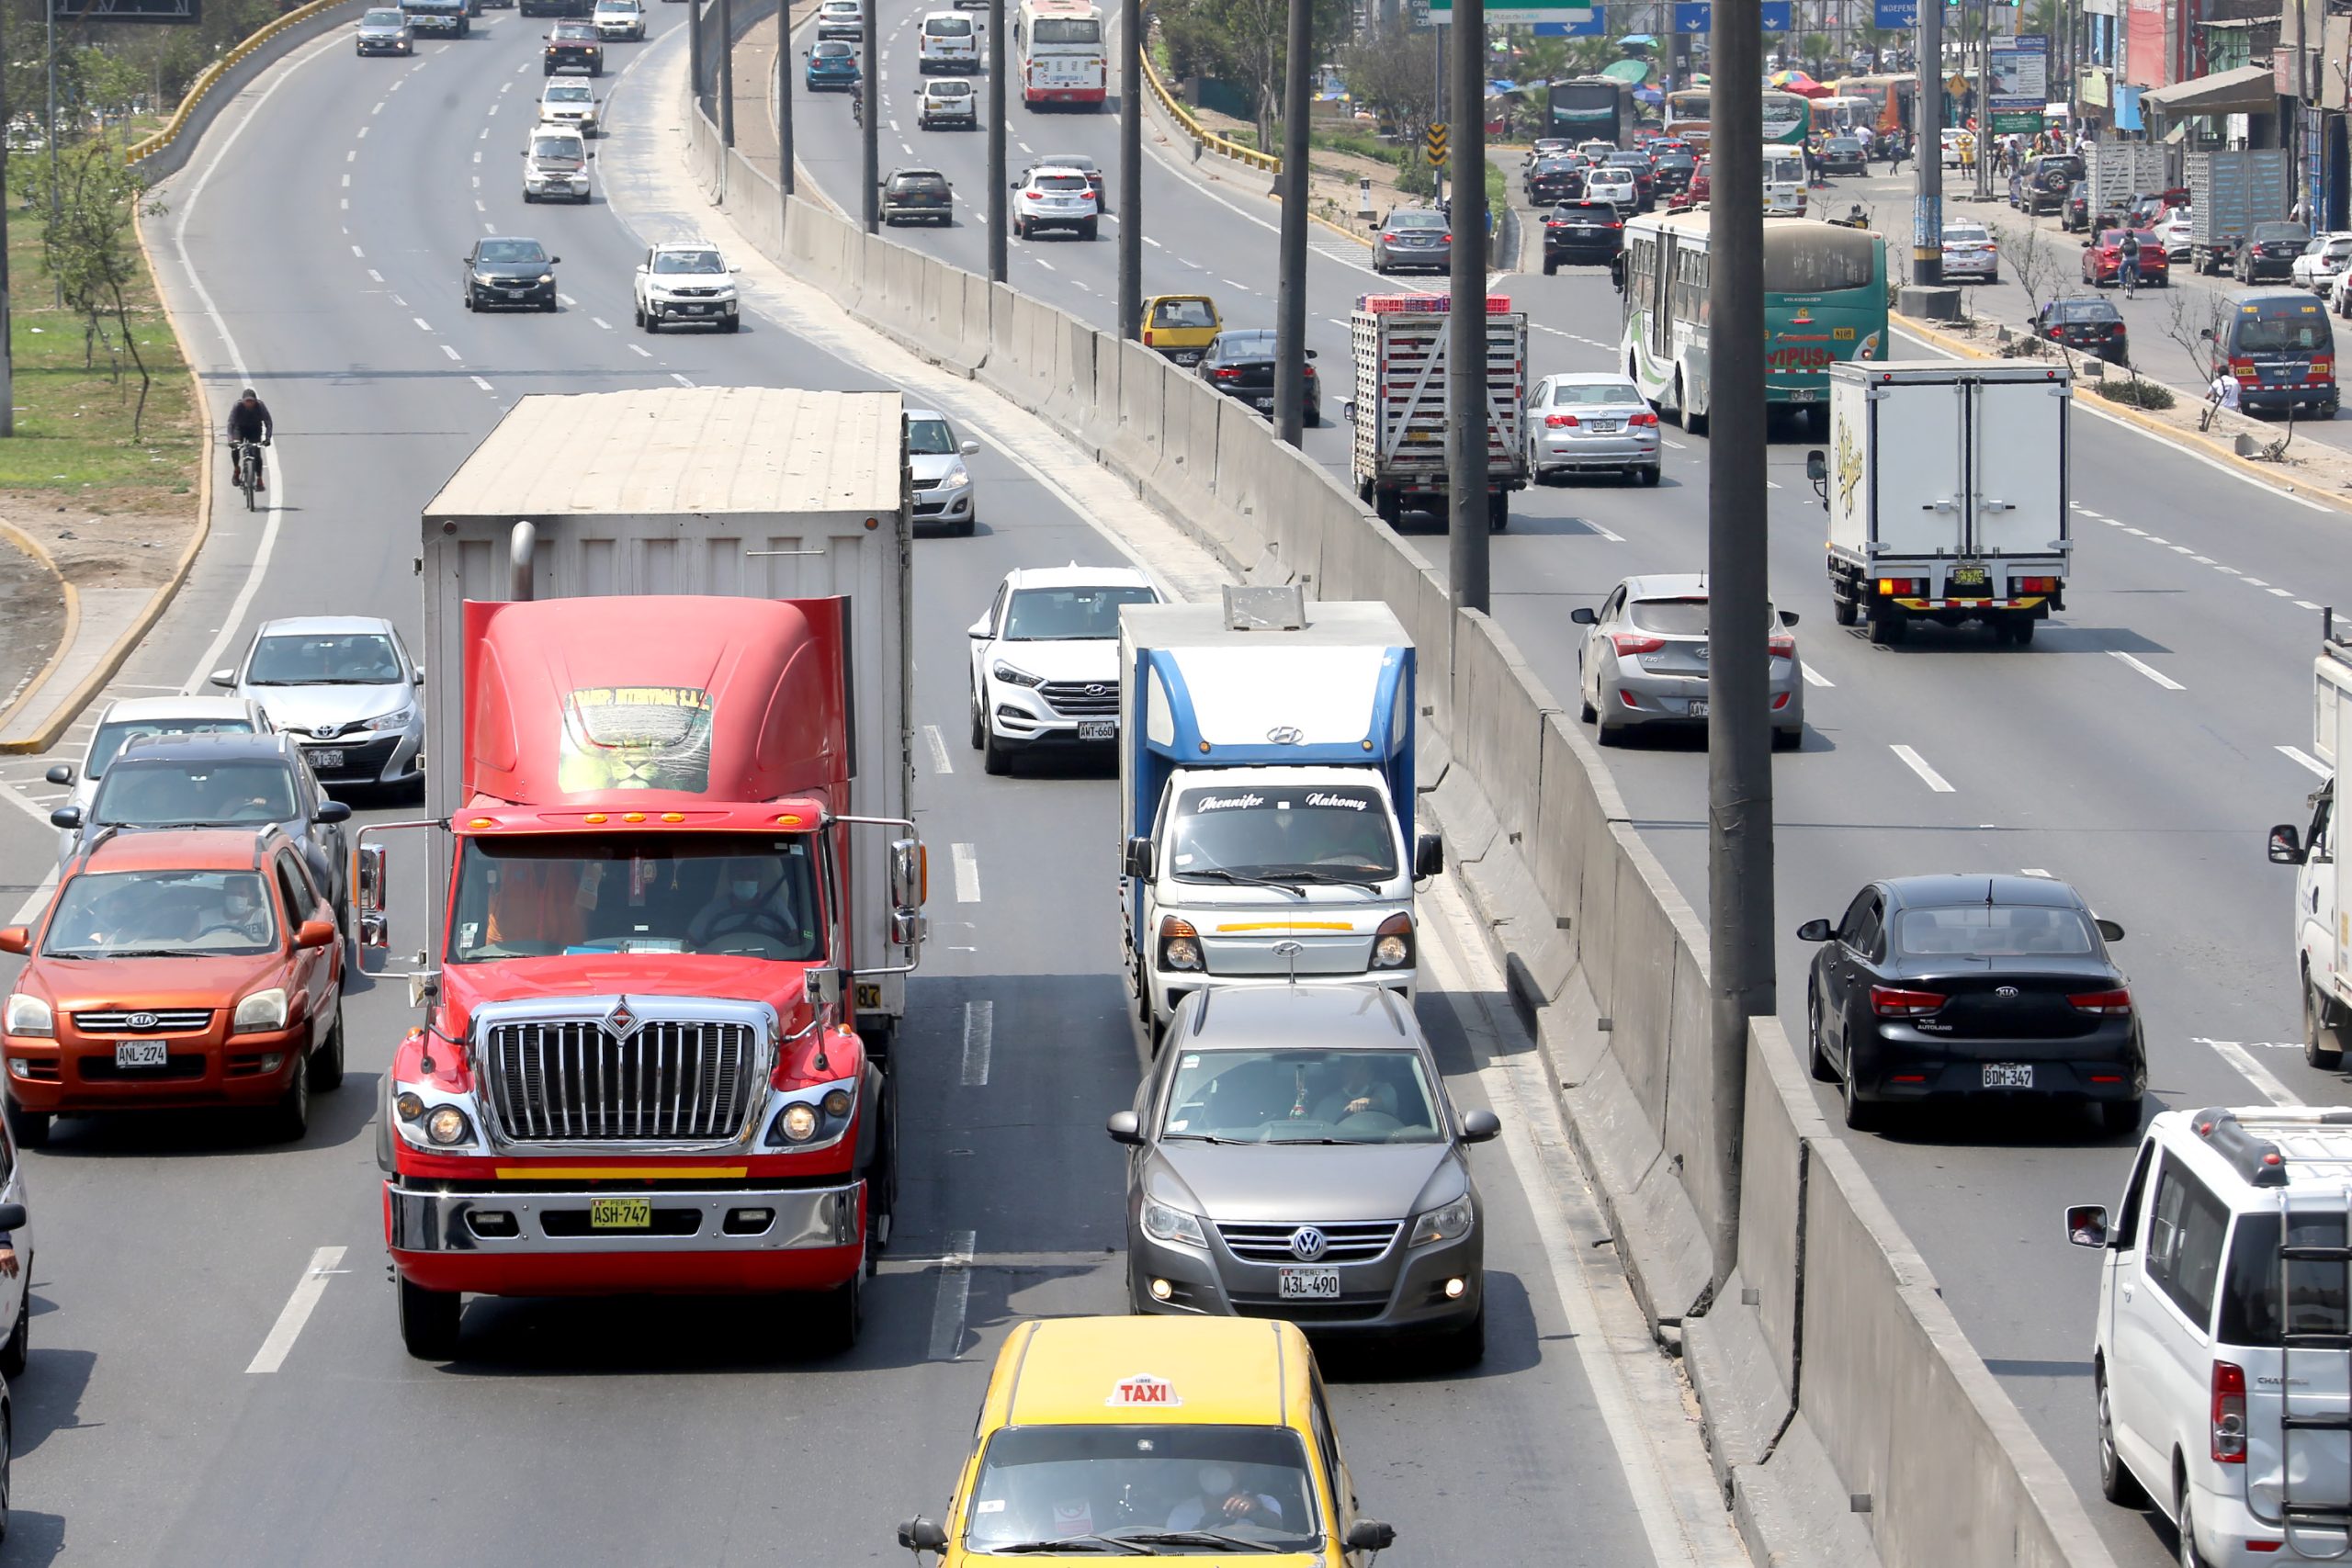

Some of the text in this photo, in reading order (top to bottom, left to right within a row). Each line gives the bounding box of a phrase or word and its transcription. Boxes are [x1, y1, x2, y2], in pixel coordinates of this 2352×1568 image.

[1080, 726, 1113, 737] AWT-660
[309, 754, 343, 765] BKI-306
[1198, 793, 1367, 813] Jhennifer Nahomy
[131, 1015, 153, 1024] KIA
[119, 1046, 164, 1062] ANL-274
[1984, 1070, 2031, 1086] BDM-347
[594, 1206, 648, 1224] ASH-747
[1283, 1276, 1338, 1293] A3L-490
[1120, 1384, 1166, 1402] TAXI
